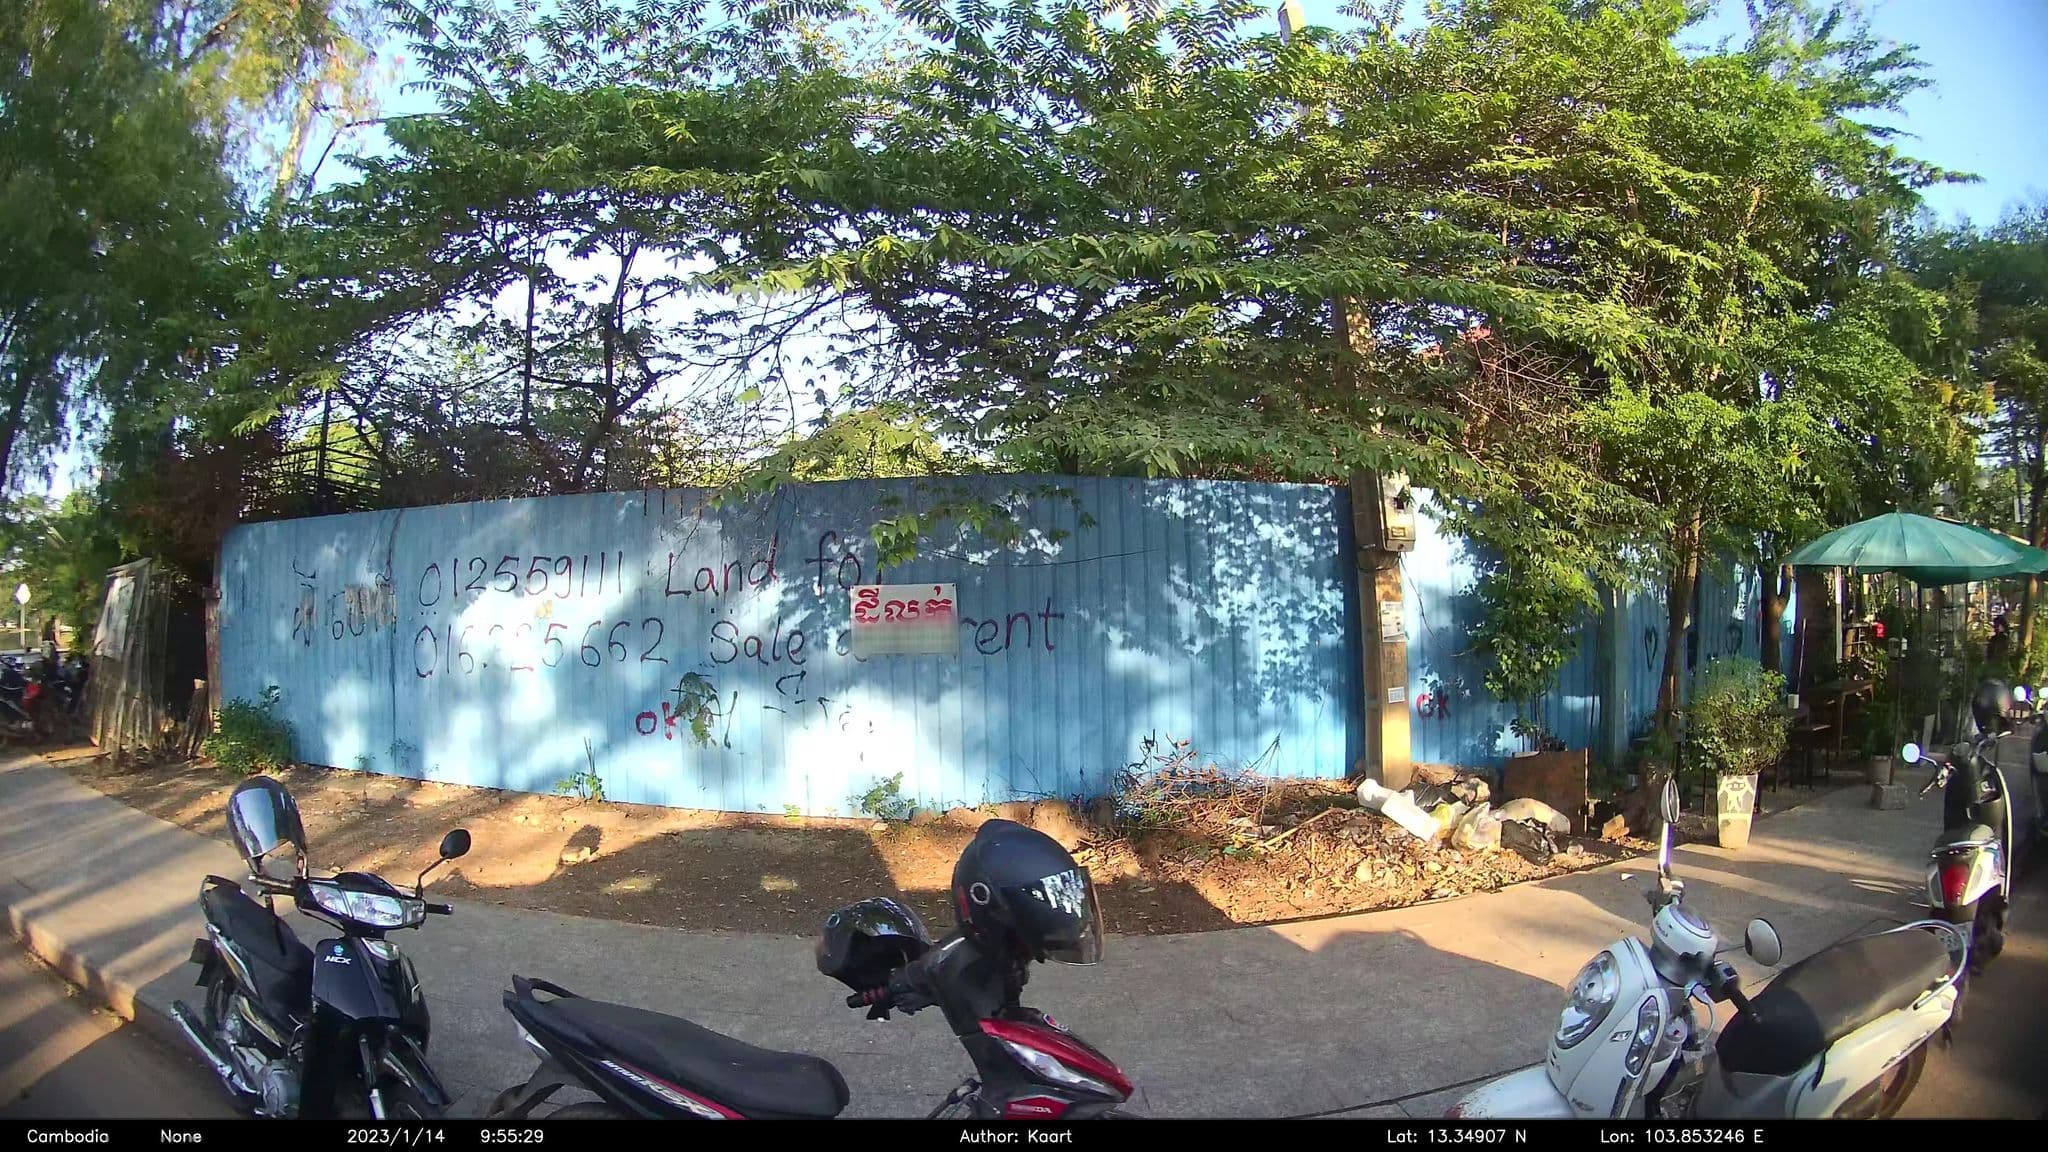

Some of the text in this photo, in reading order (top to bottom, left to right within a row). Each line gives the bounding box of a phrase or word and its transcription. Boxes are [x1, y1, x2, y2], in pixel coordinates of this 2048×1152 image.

[419, 551, 623, 607] 012559111
[665, 529, 778, 597] Land
[710, 616, 808, 666] Sale
